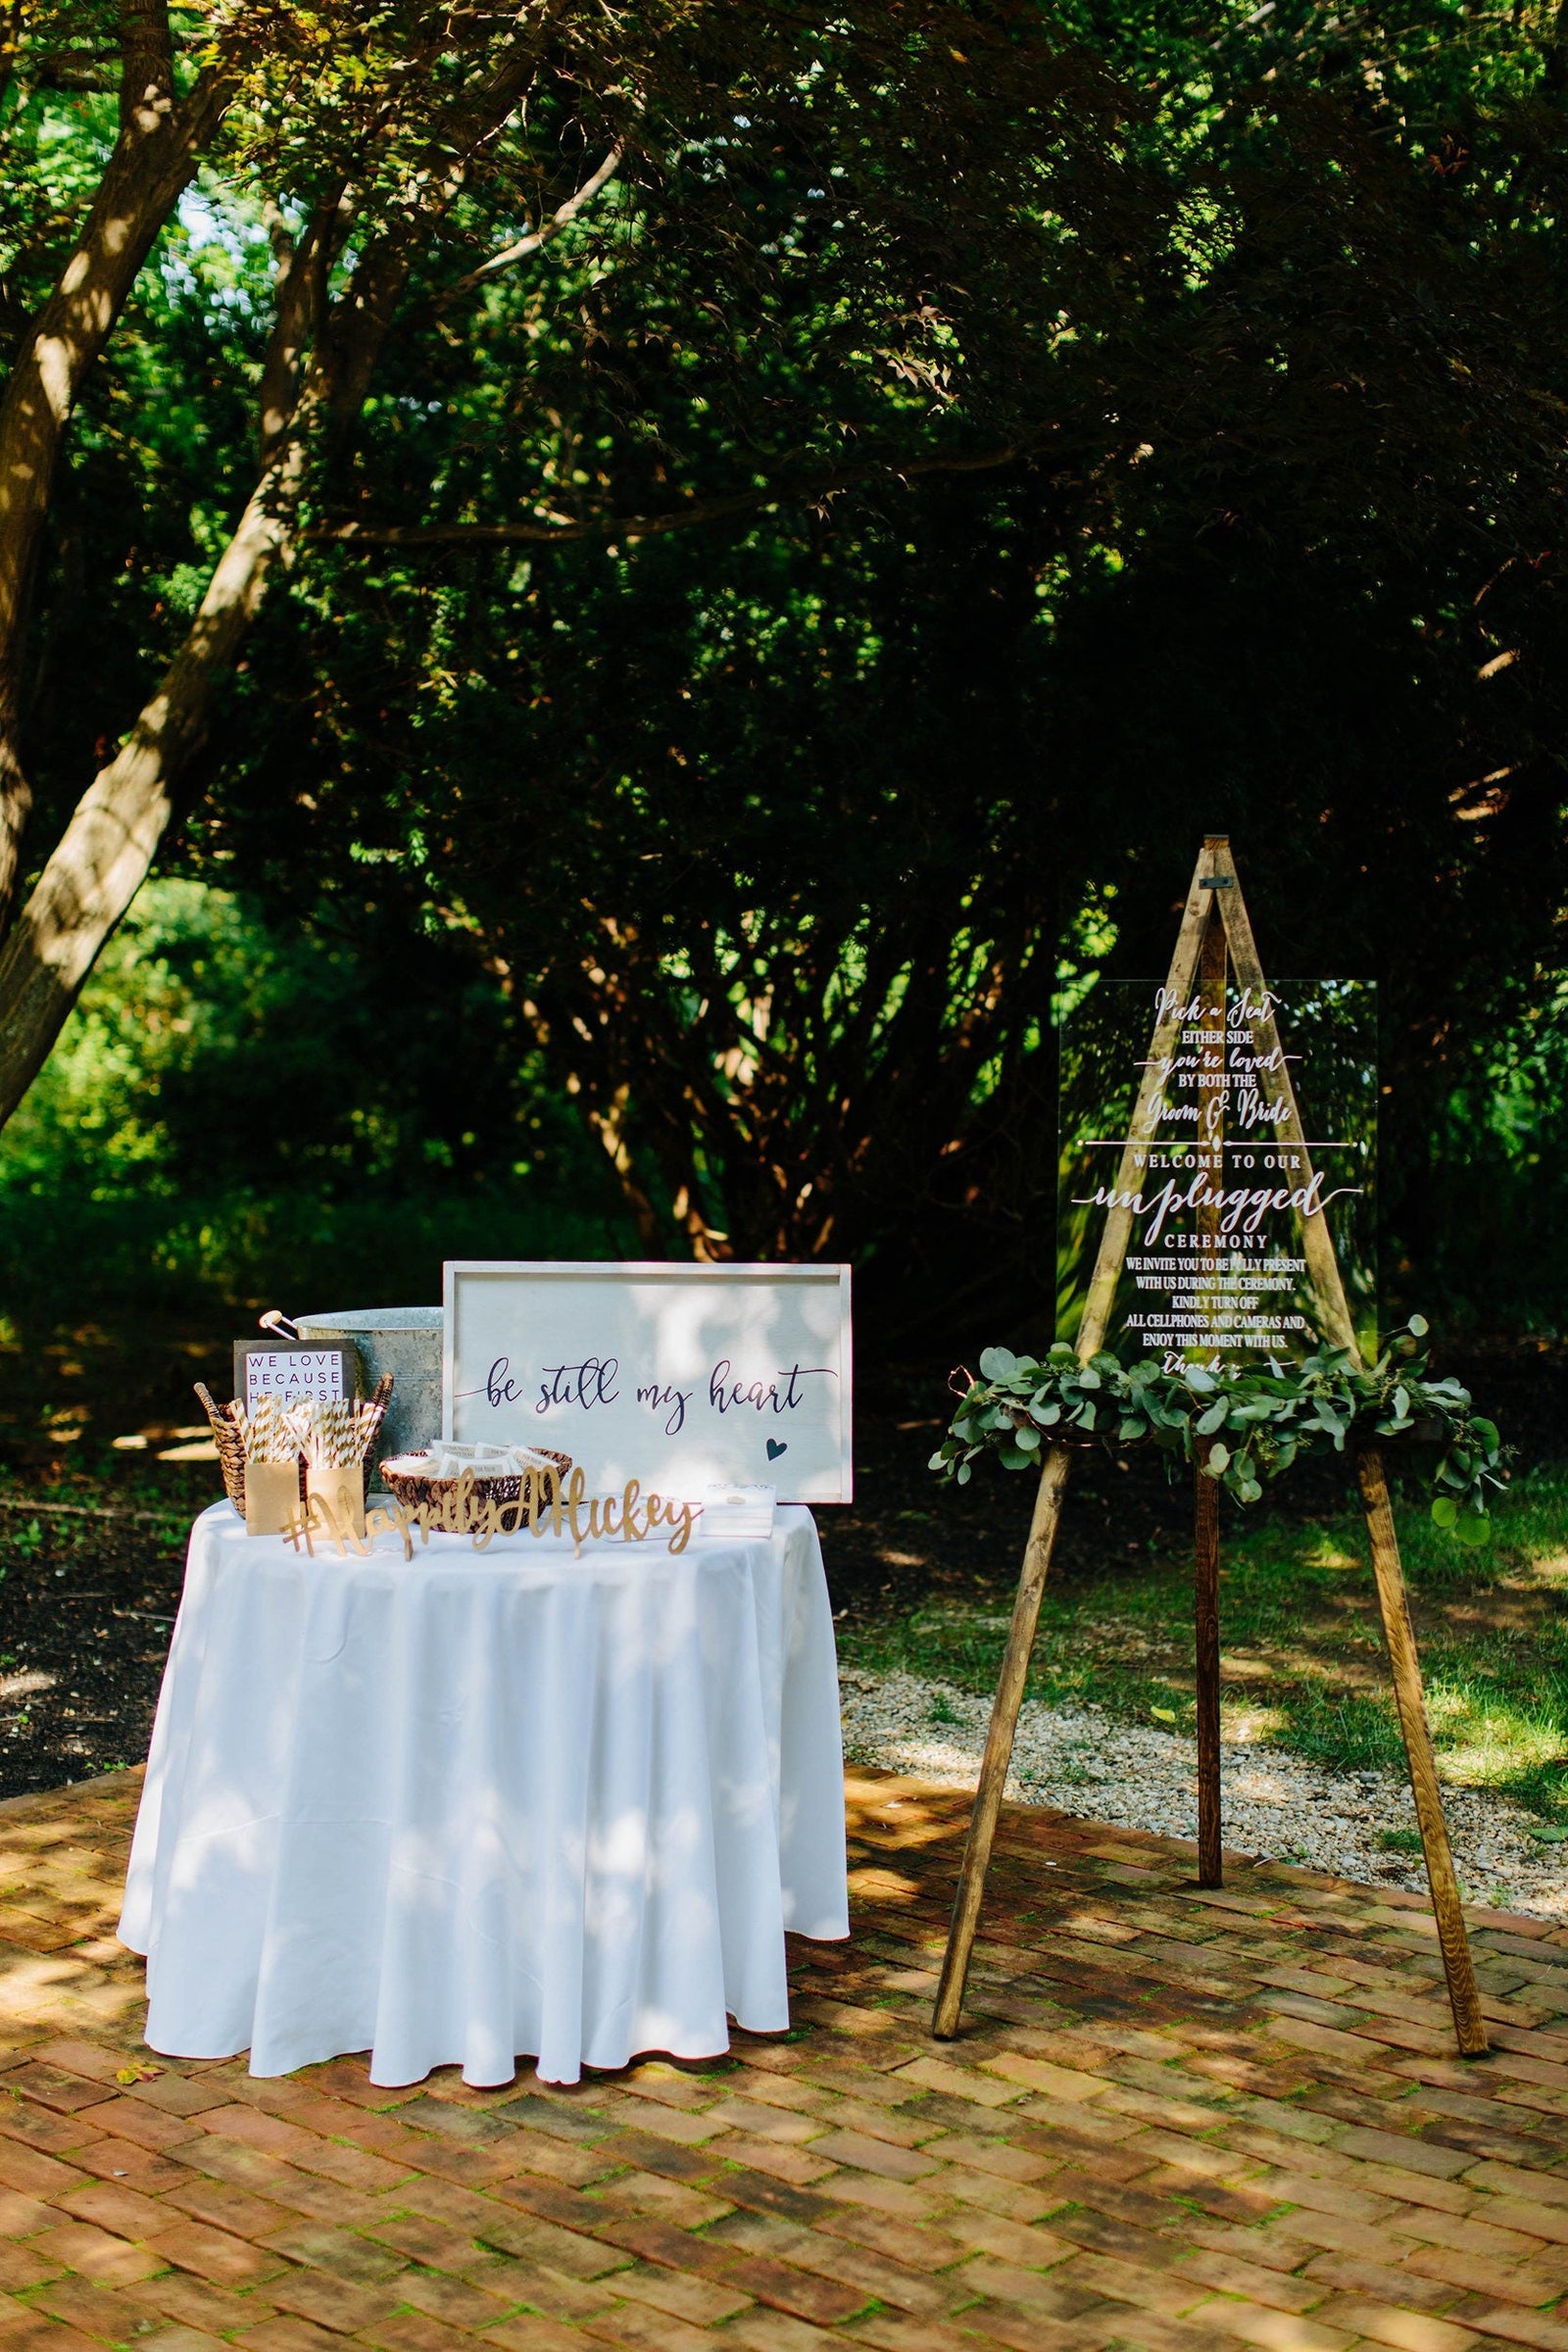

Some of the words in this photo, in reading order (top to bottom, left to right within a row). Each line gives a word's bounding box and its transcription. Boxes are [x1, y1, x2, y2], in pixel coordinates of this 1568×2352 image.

[1154, 987, 1206, 1026] Pick
[1209, 1007, 1222, 1017] a
[1227, 987, 1283, 1028] Seat
[1182, 1031, 1224, 1044] EITHER
[1226, 1031, 1253, 1044] SIDE
[1133, 1048, 1223, 1086] you're
[1228, 1047, 1302, 1072] loved
[1178, 1074, 1195, 1087] BY
[1198, 1074, 1231, 1087] BOTH
[1234, 1074, 1257, 1088] THE
[1142, 1096, 1203, 1134] Groom
[1206, 1091, 1231, 1130] &
[1237, 1088, 1293, 1130] Bride
[1133, 1154, 1223, 1168] WELCOME
[1232, 1154, 1255, 1168] TO
[1264, 1154, 1301, 1169] OUR
[1071, 1171, 1364, 1247] unplugged
[1164, 1234, 1268, 1249] CEREMONY
[1126, 1256, 1142, 1270] WE
[1143, 1257, 1176, 1271] INVITE
[1177, 1257, 1200, 1271] YOU
[1200, 1257, 1214, 1271] TO
[1215, 1258, 1229, 1271] BE
[1262, 1258, 1306, 1272] PRESENT
[1136, 1276, 1162, 1290] WITH
[1163, 1276, 1177, 1290] US
[1178, 1277, 1216, 1290] DURING
[1218, 1277, 1238, 1291] THE
[1239, 1278, 1296, 1292] CEREMONY.
[1172, 1296, 1209, 1309] KINDLY
[1211, 1296, 1239, 1309] TURN
[1240, 1297, 1259, 1309] OFF
[1126, 1314, 1146, 1327] ALL
[1211, 1314, 1233, 1328] AND
[1234, 1315, 1282, 1329] CAMERAS
[1283, 1315, 1305, 1329] AND
[1143, 1333, 1174, 1347] ENJOY
[1175, 1334, 1199, 1347] THIS
[1200, 1334, 1243, 1348] MOMENT
[1244, 1335, 1271, 1348] WITH
[1272, 1335, 1290, 1348] US.
[249, 1356, 276, 1367] WE
[289, 1354, 339, 1366] LOVE
[250, 1372, 339, 1385] BECAUSE
[454, 1357, 522, 1407] be
[535, 1356, 619, 1414] still
[636, 1383, 693, 1435] my
[710, 1360, 839, 1414] heart
